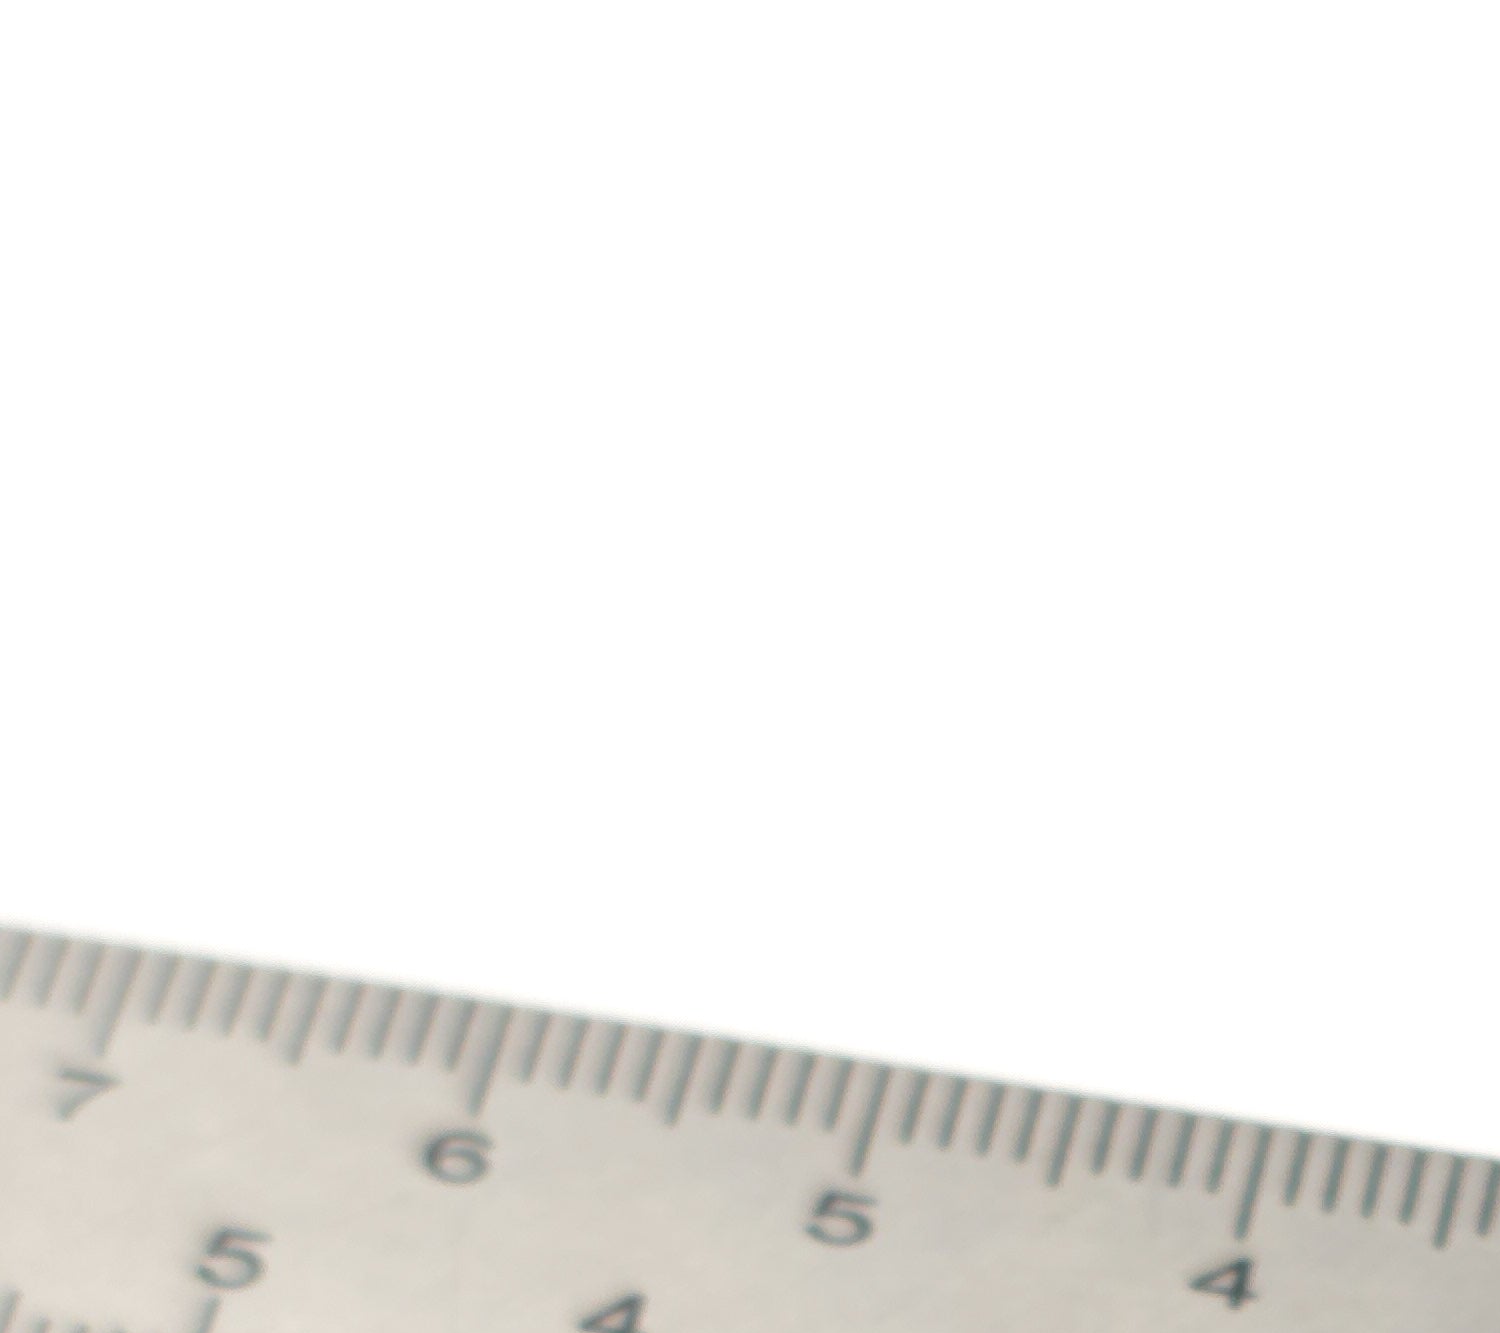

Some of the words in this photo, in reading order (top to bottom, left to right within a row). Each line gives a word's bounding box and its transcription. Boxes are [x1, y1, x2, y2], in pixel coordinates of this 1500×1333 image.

[54, 1066, 119, 1121] 7
[418, 1128, 492, 1184] 6
[806, 1186, 875, 1246] 5
[194, 1225, 266, 1290] 5
[1190, 1256, 1256, 1308] 4
